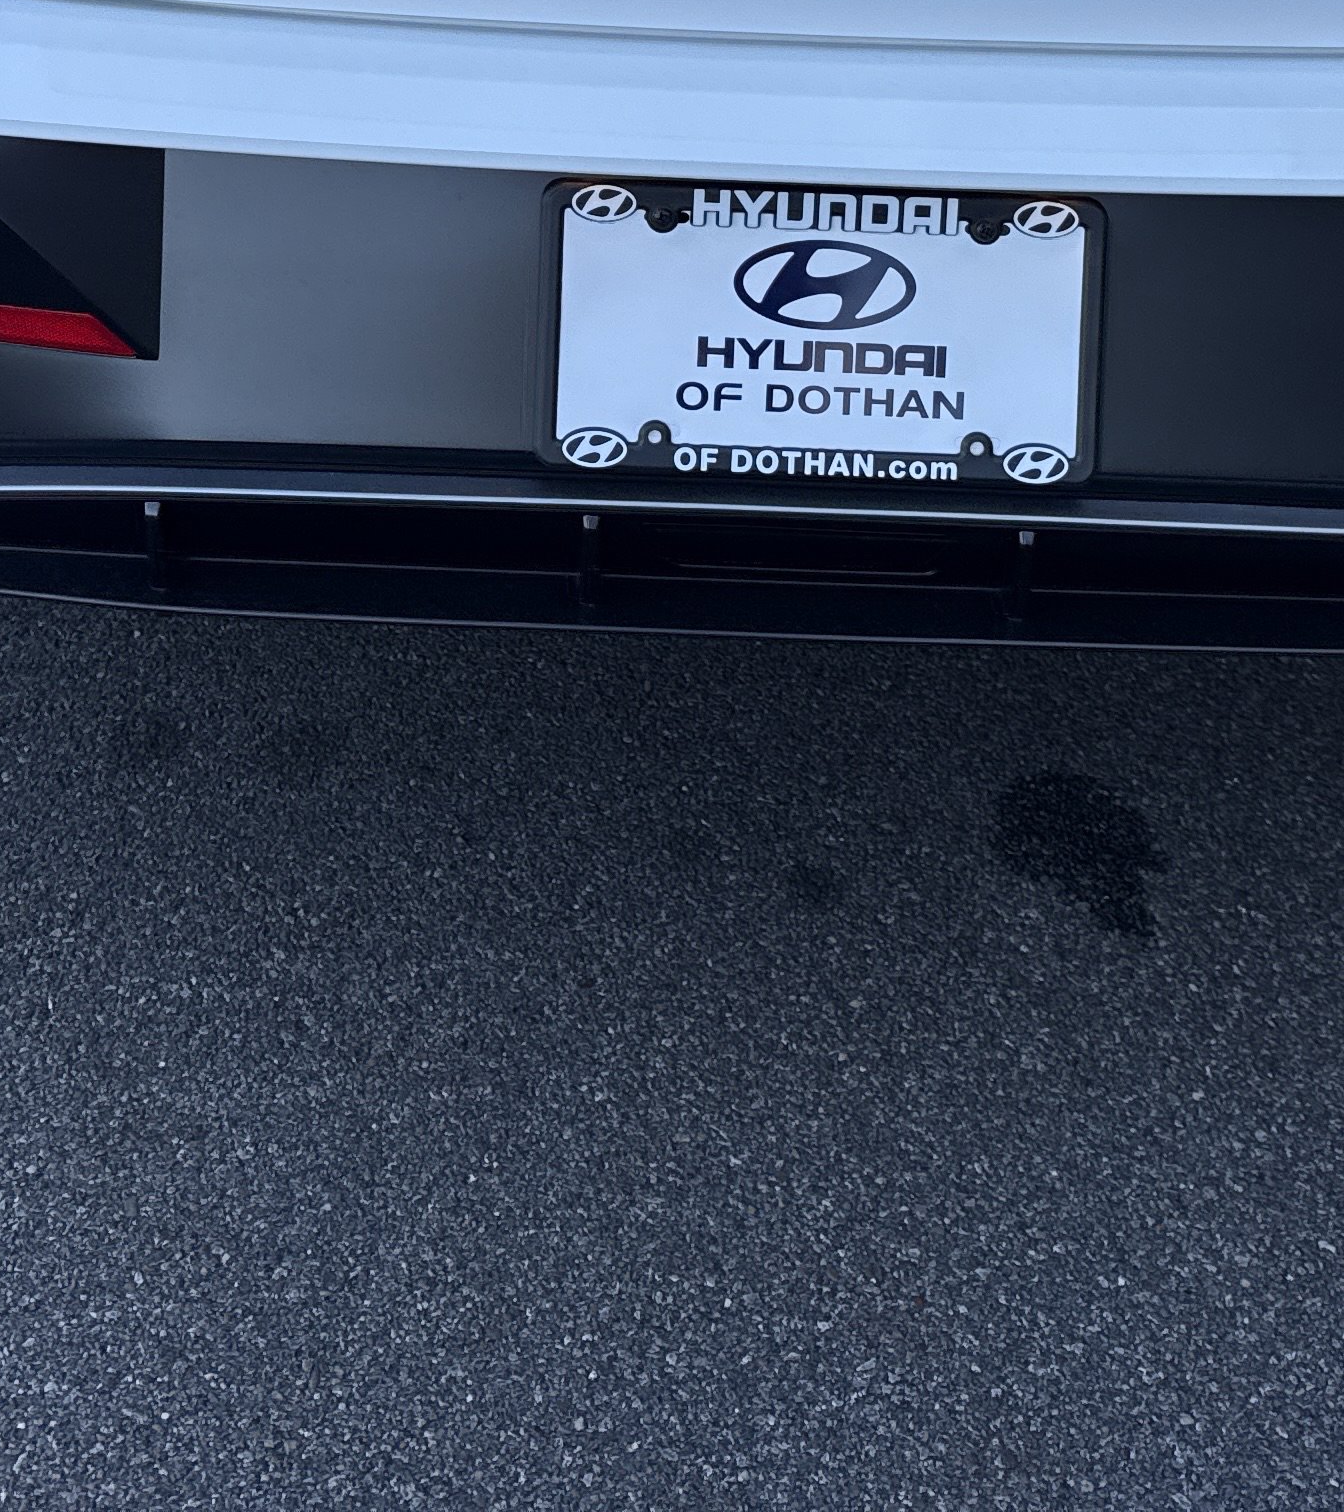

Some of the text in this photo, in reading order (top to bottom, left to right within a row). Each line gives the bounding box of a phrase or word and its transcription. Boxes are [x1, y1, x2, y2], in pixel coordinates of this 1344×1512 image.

[690, 187, 960, 237] HYUNDAI
[696, 335, 947, 379] HYUNDAI
[675, 381, 965, 420] OF DOTHAN
[673, 446, 957, 480] OF DOTHAN.com
